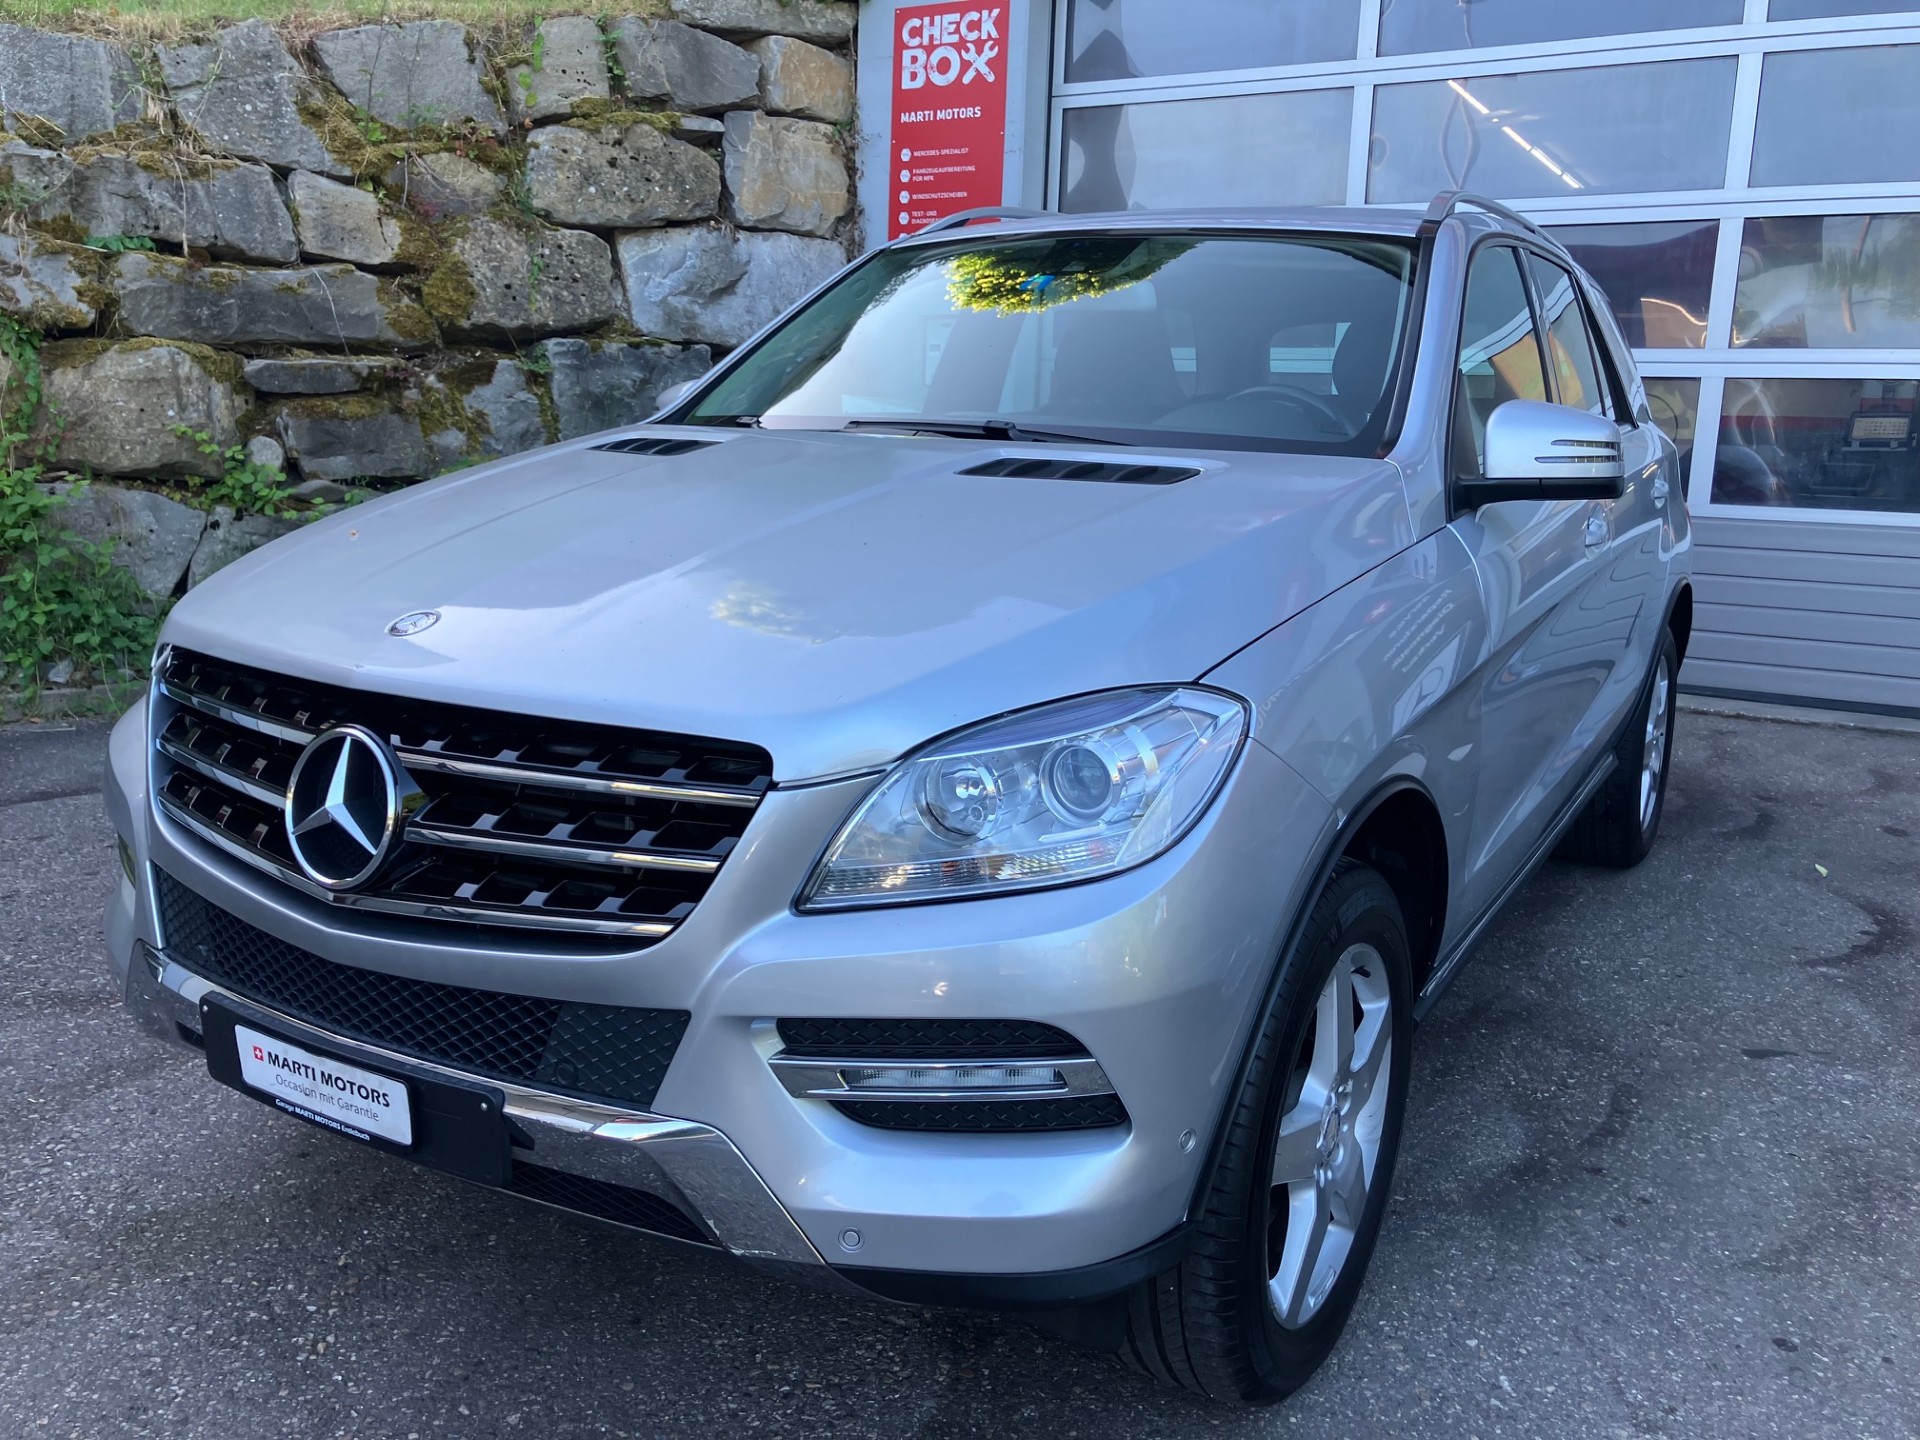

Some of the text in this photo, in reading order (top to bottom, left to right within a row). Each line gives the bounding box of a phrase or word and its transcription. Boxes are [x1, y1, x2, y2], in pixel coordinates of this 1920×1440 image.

[902, 8, 1000, 47] CHECK
[901, 41, 999, 90] BOX
[901, 106, 981, 123] MARTI MOTORS
[913, 147, 969, 157] MERCEDES-SPEZIALIST
[912, 165, 976, 174] FAHRZEUGAUFBEREITUNG
[912, 191, 968, 200] WINDSCHUTZSCHEIBEN
[267, 1051, 390, 1107] MARTI MOTORS
[275, 1074, 380, 1122] Occasion mit Garantie
[275, 1098, 295, 1112] Garage
[295, 1106, 315, 1120] MARTI
[315, 1114, 341, 1130] MOTORS
